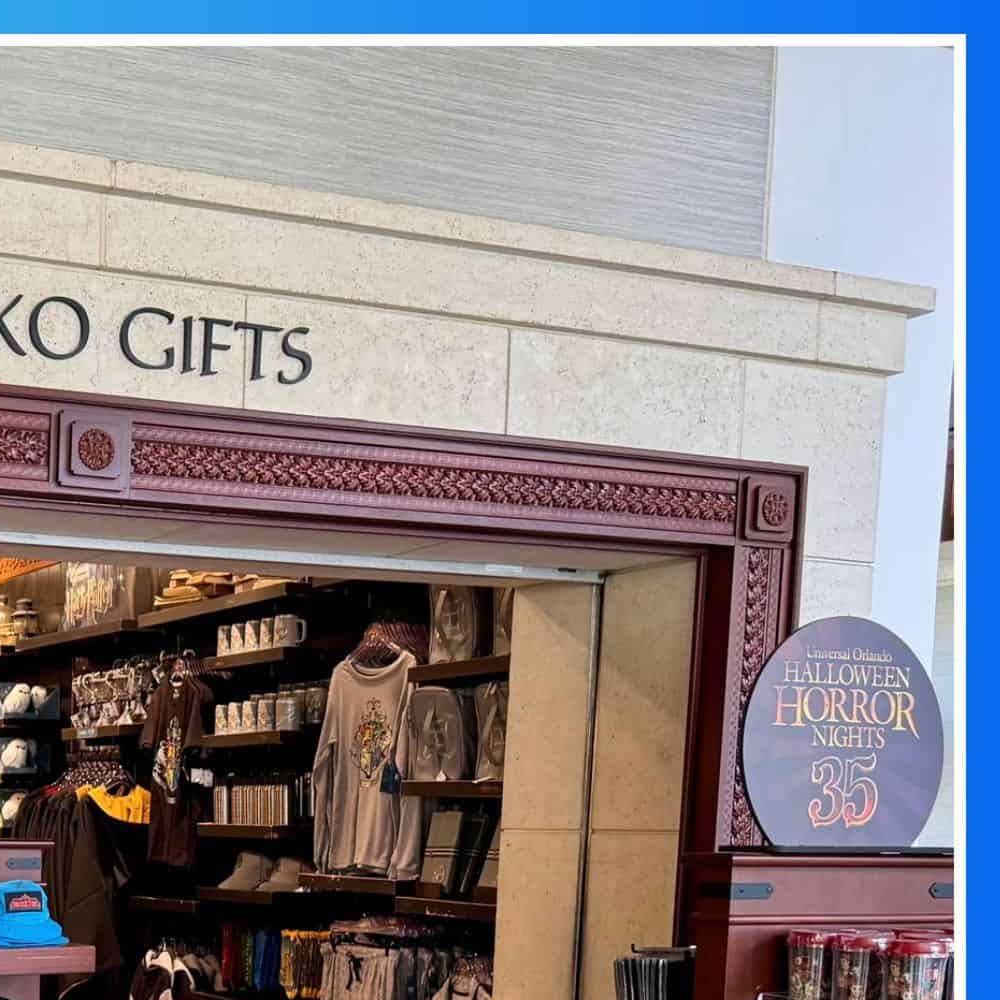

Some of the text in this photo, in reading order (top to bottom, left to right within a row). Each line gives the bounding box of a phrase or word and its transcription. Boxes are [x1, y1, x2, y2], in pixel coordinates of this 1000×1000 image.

[119, 307, 312, 385] GIFTS
[807, 646, 892, 662] Universal Orlando
[783, 661, 910, 688] HALLOWEEN
[772, 685, 920, 739] HORROR
[811, 725, 886, 749] NIGHTS
[808, 752, 878, 828] 35
